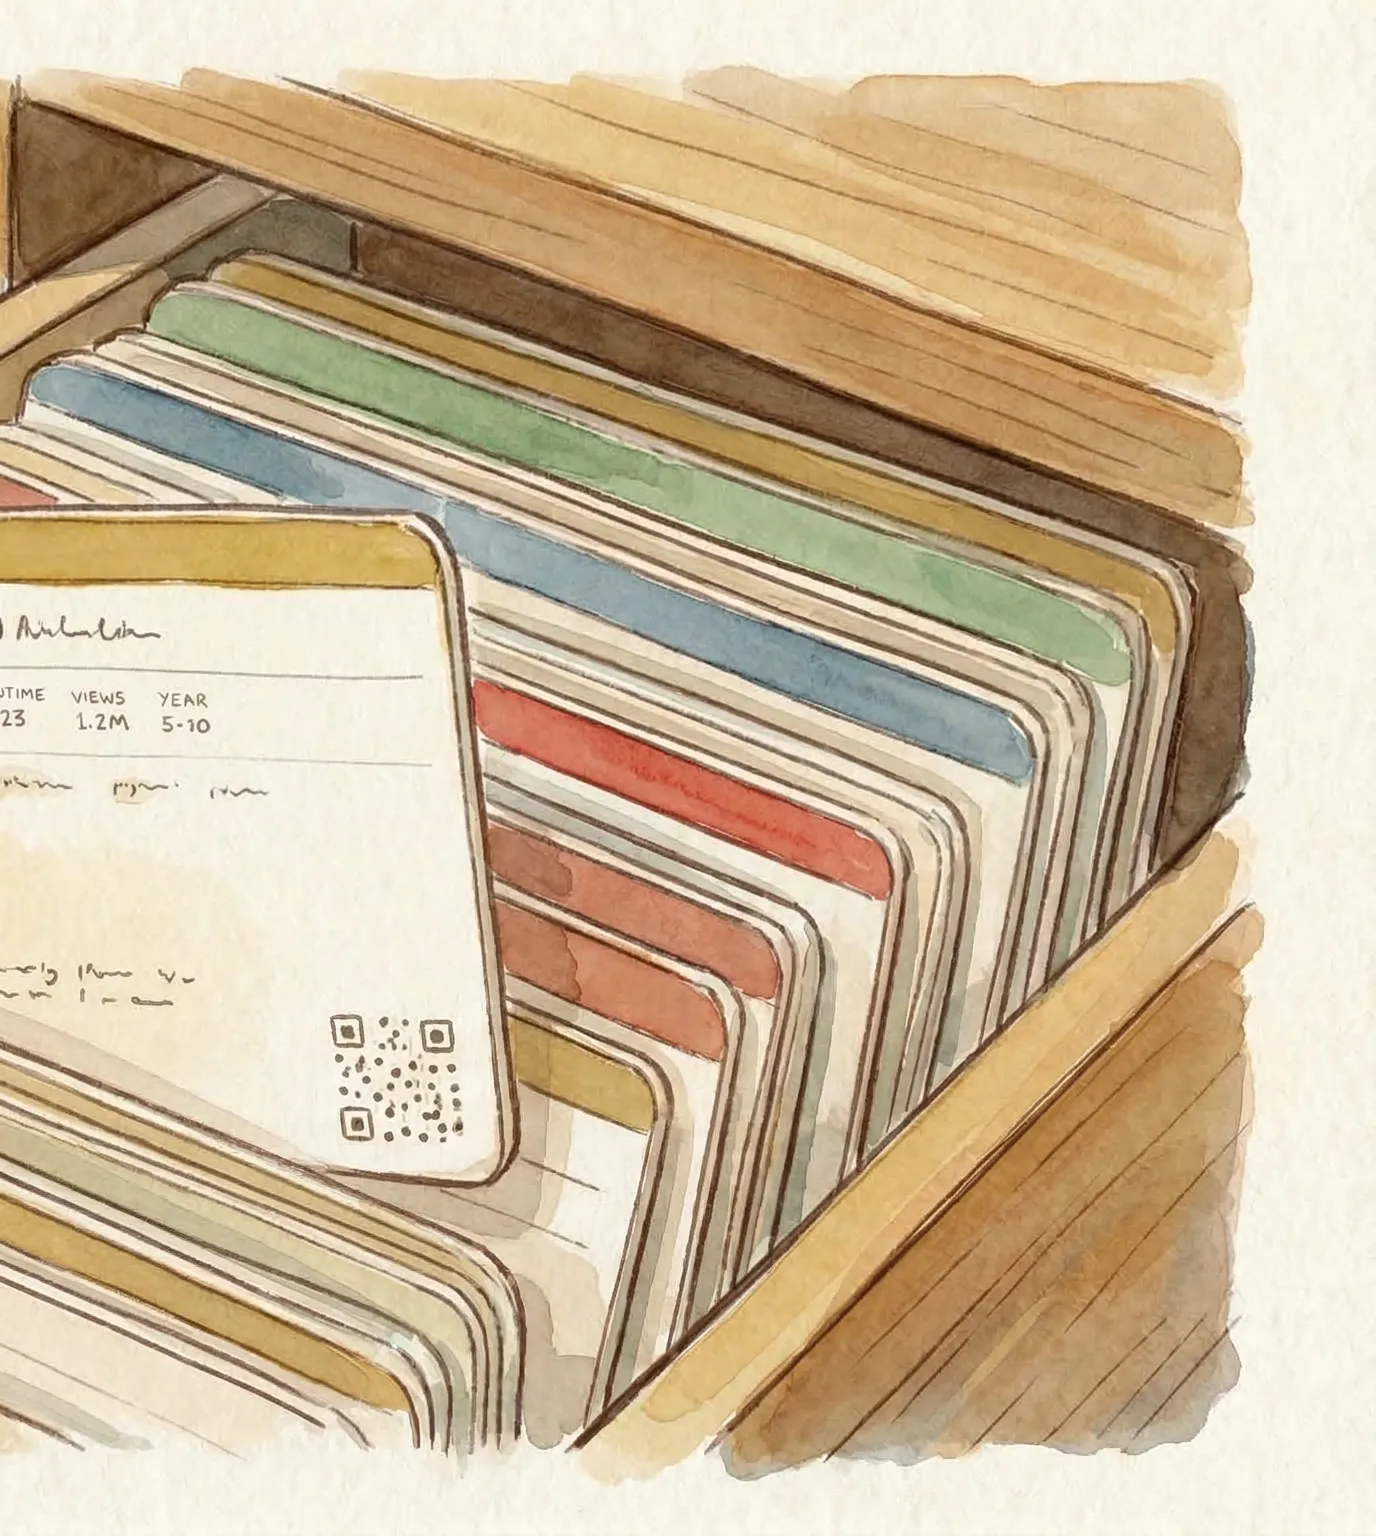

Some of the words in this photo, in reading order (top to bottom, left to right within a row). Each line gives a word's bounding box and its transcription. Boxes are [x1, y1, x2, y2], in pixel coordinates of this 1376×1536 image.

[71, 690, 126, 705] VIEWS
[159, 692, 209, 708] YEAR
[75, 711, 130, 732] 1.2M
